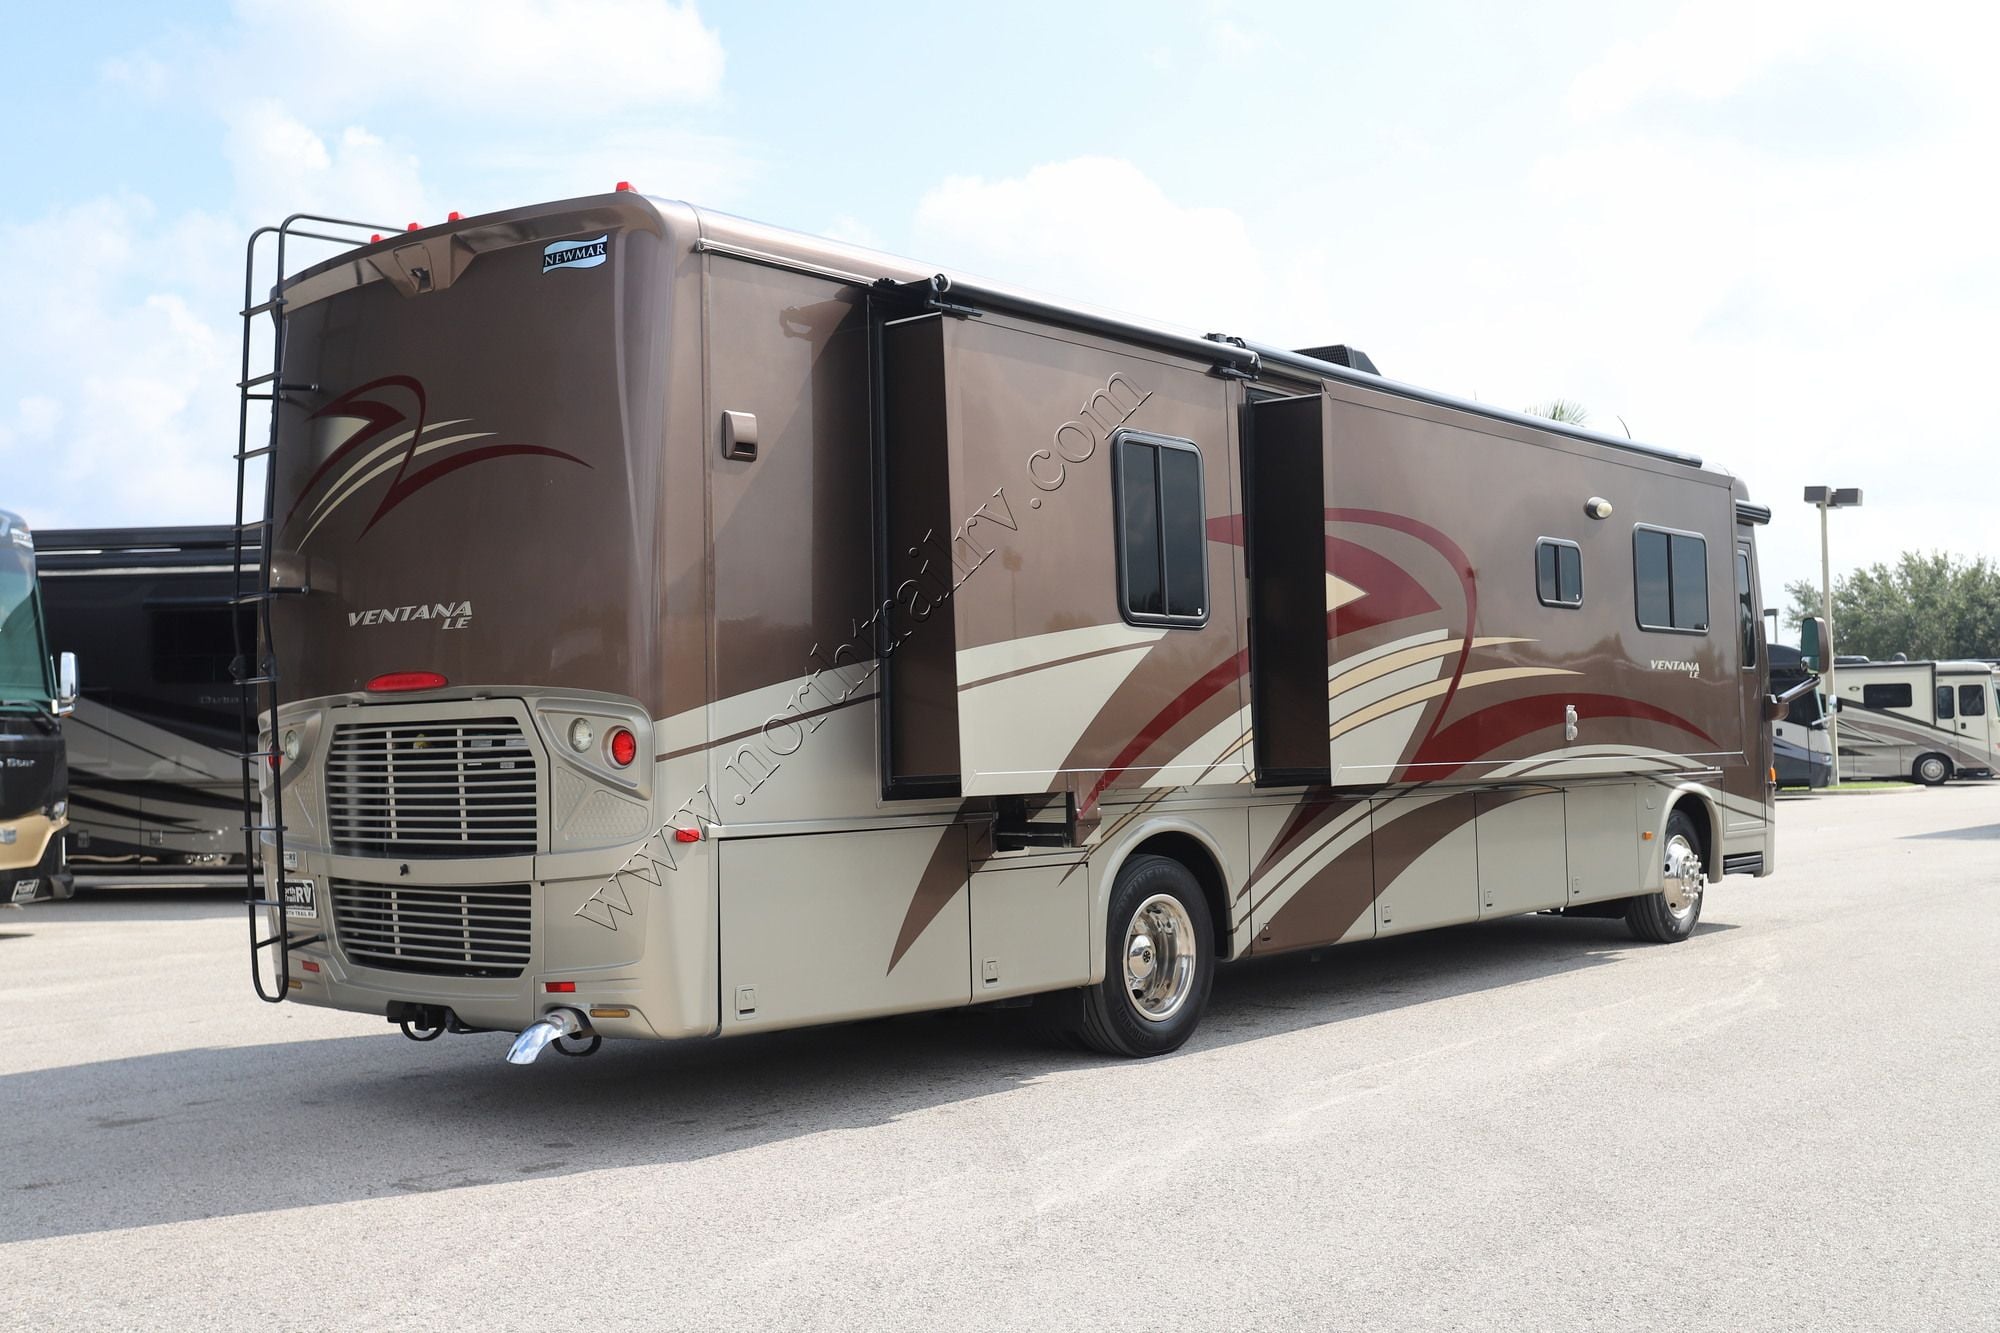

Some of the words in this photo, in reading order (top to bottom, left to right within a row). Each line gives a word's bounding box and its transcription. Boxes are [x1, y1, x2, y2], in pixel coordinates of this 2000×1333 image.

[544, 243, 605, 266] NEWMAR
[348, 600, 473, 627] VENTANA
[441, 616, 473, 630] LE
[1650, 660, 1699, 671] VENTANA
[295, 886, 311, 903] RV
